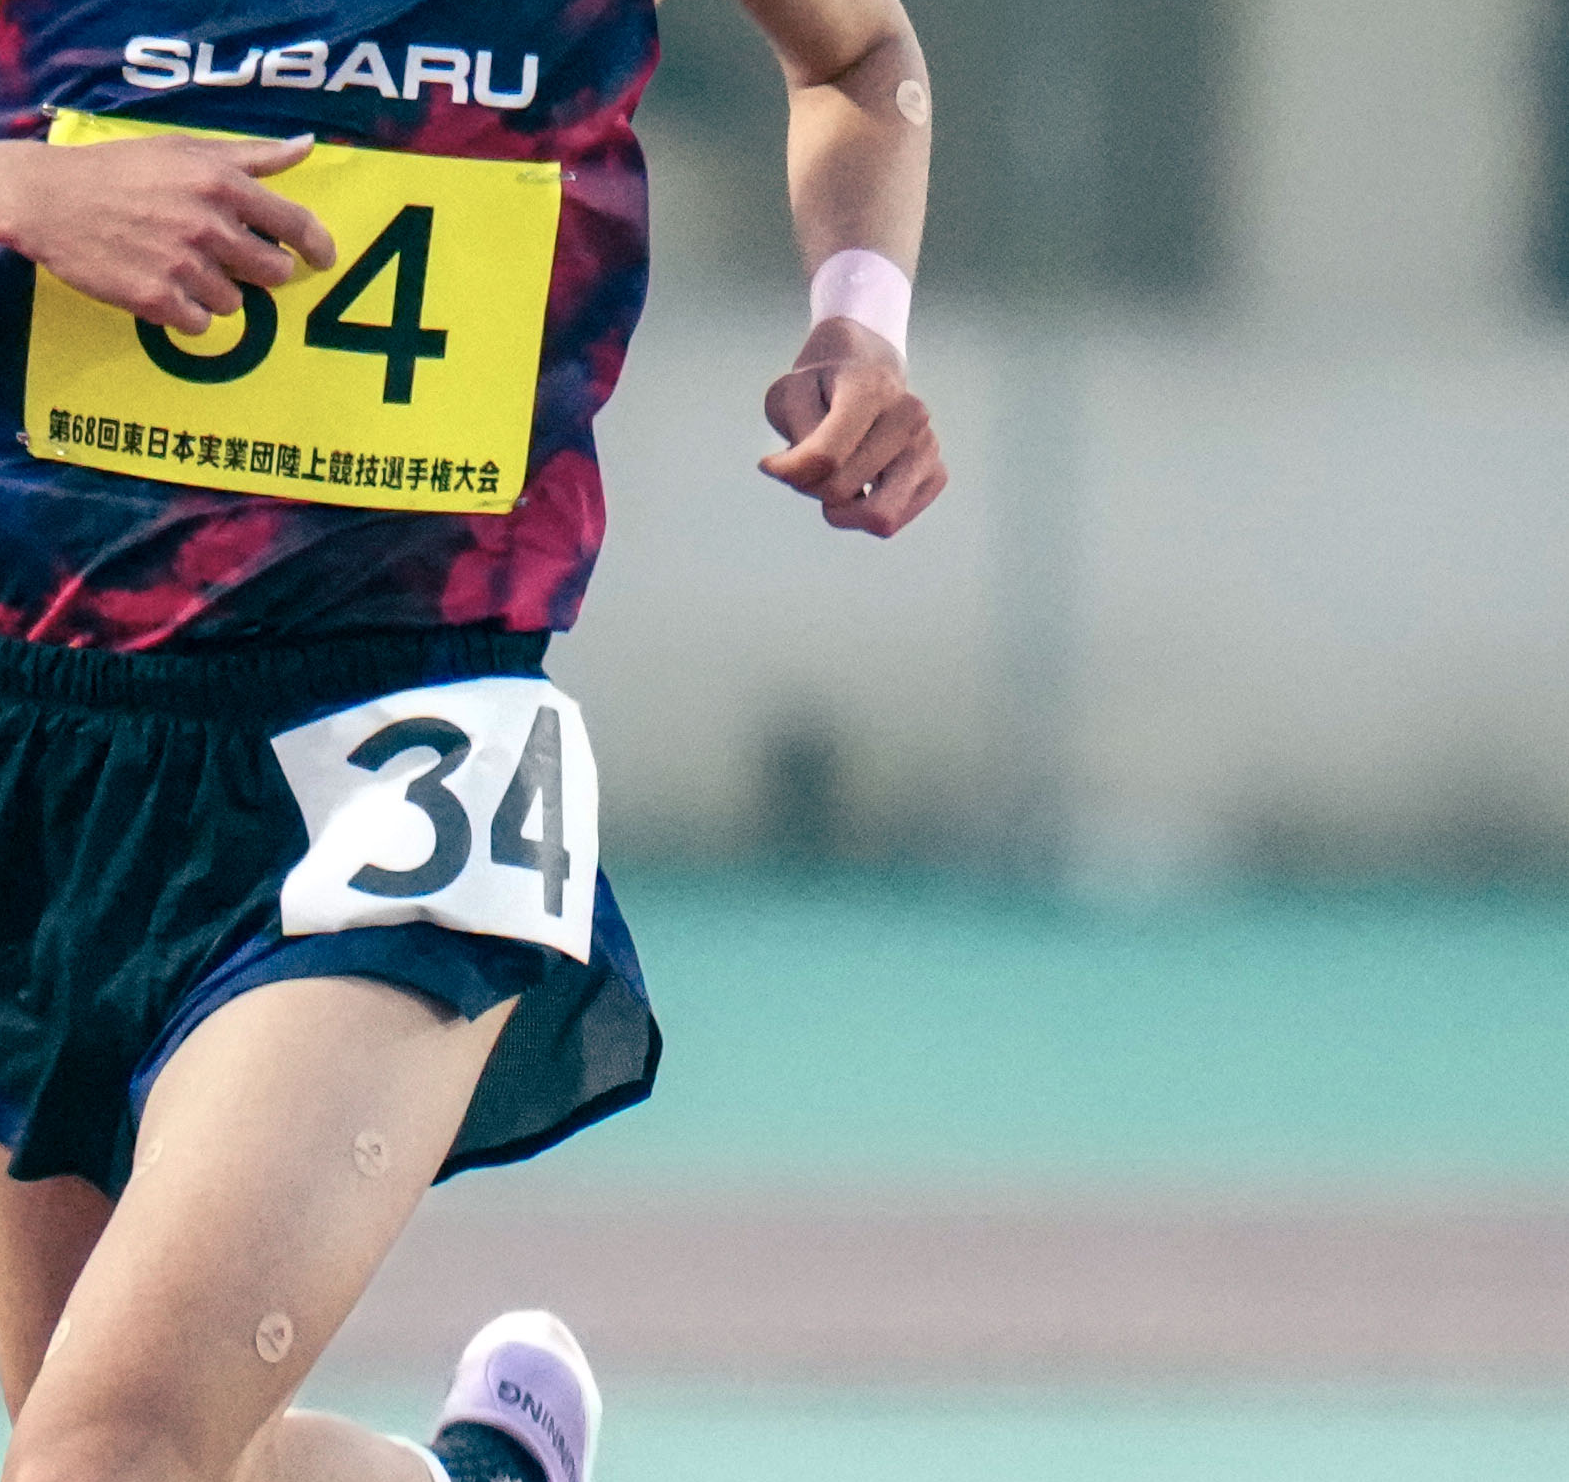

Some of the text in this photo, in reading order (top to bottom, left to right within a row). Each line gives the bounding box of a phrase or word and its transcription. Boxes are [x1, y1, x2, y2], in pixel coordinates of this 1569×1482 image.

[122, 35, 539, 110] SUBARU
[48, 407, 501, 496] 第68回東日本実業団陸上競技選手権大会
[346, 704, 571, 918] 34
